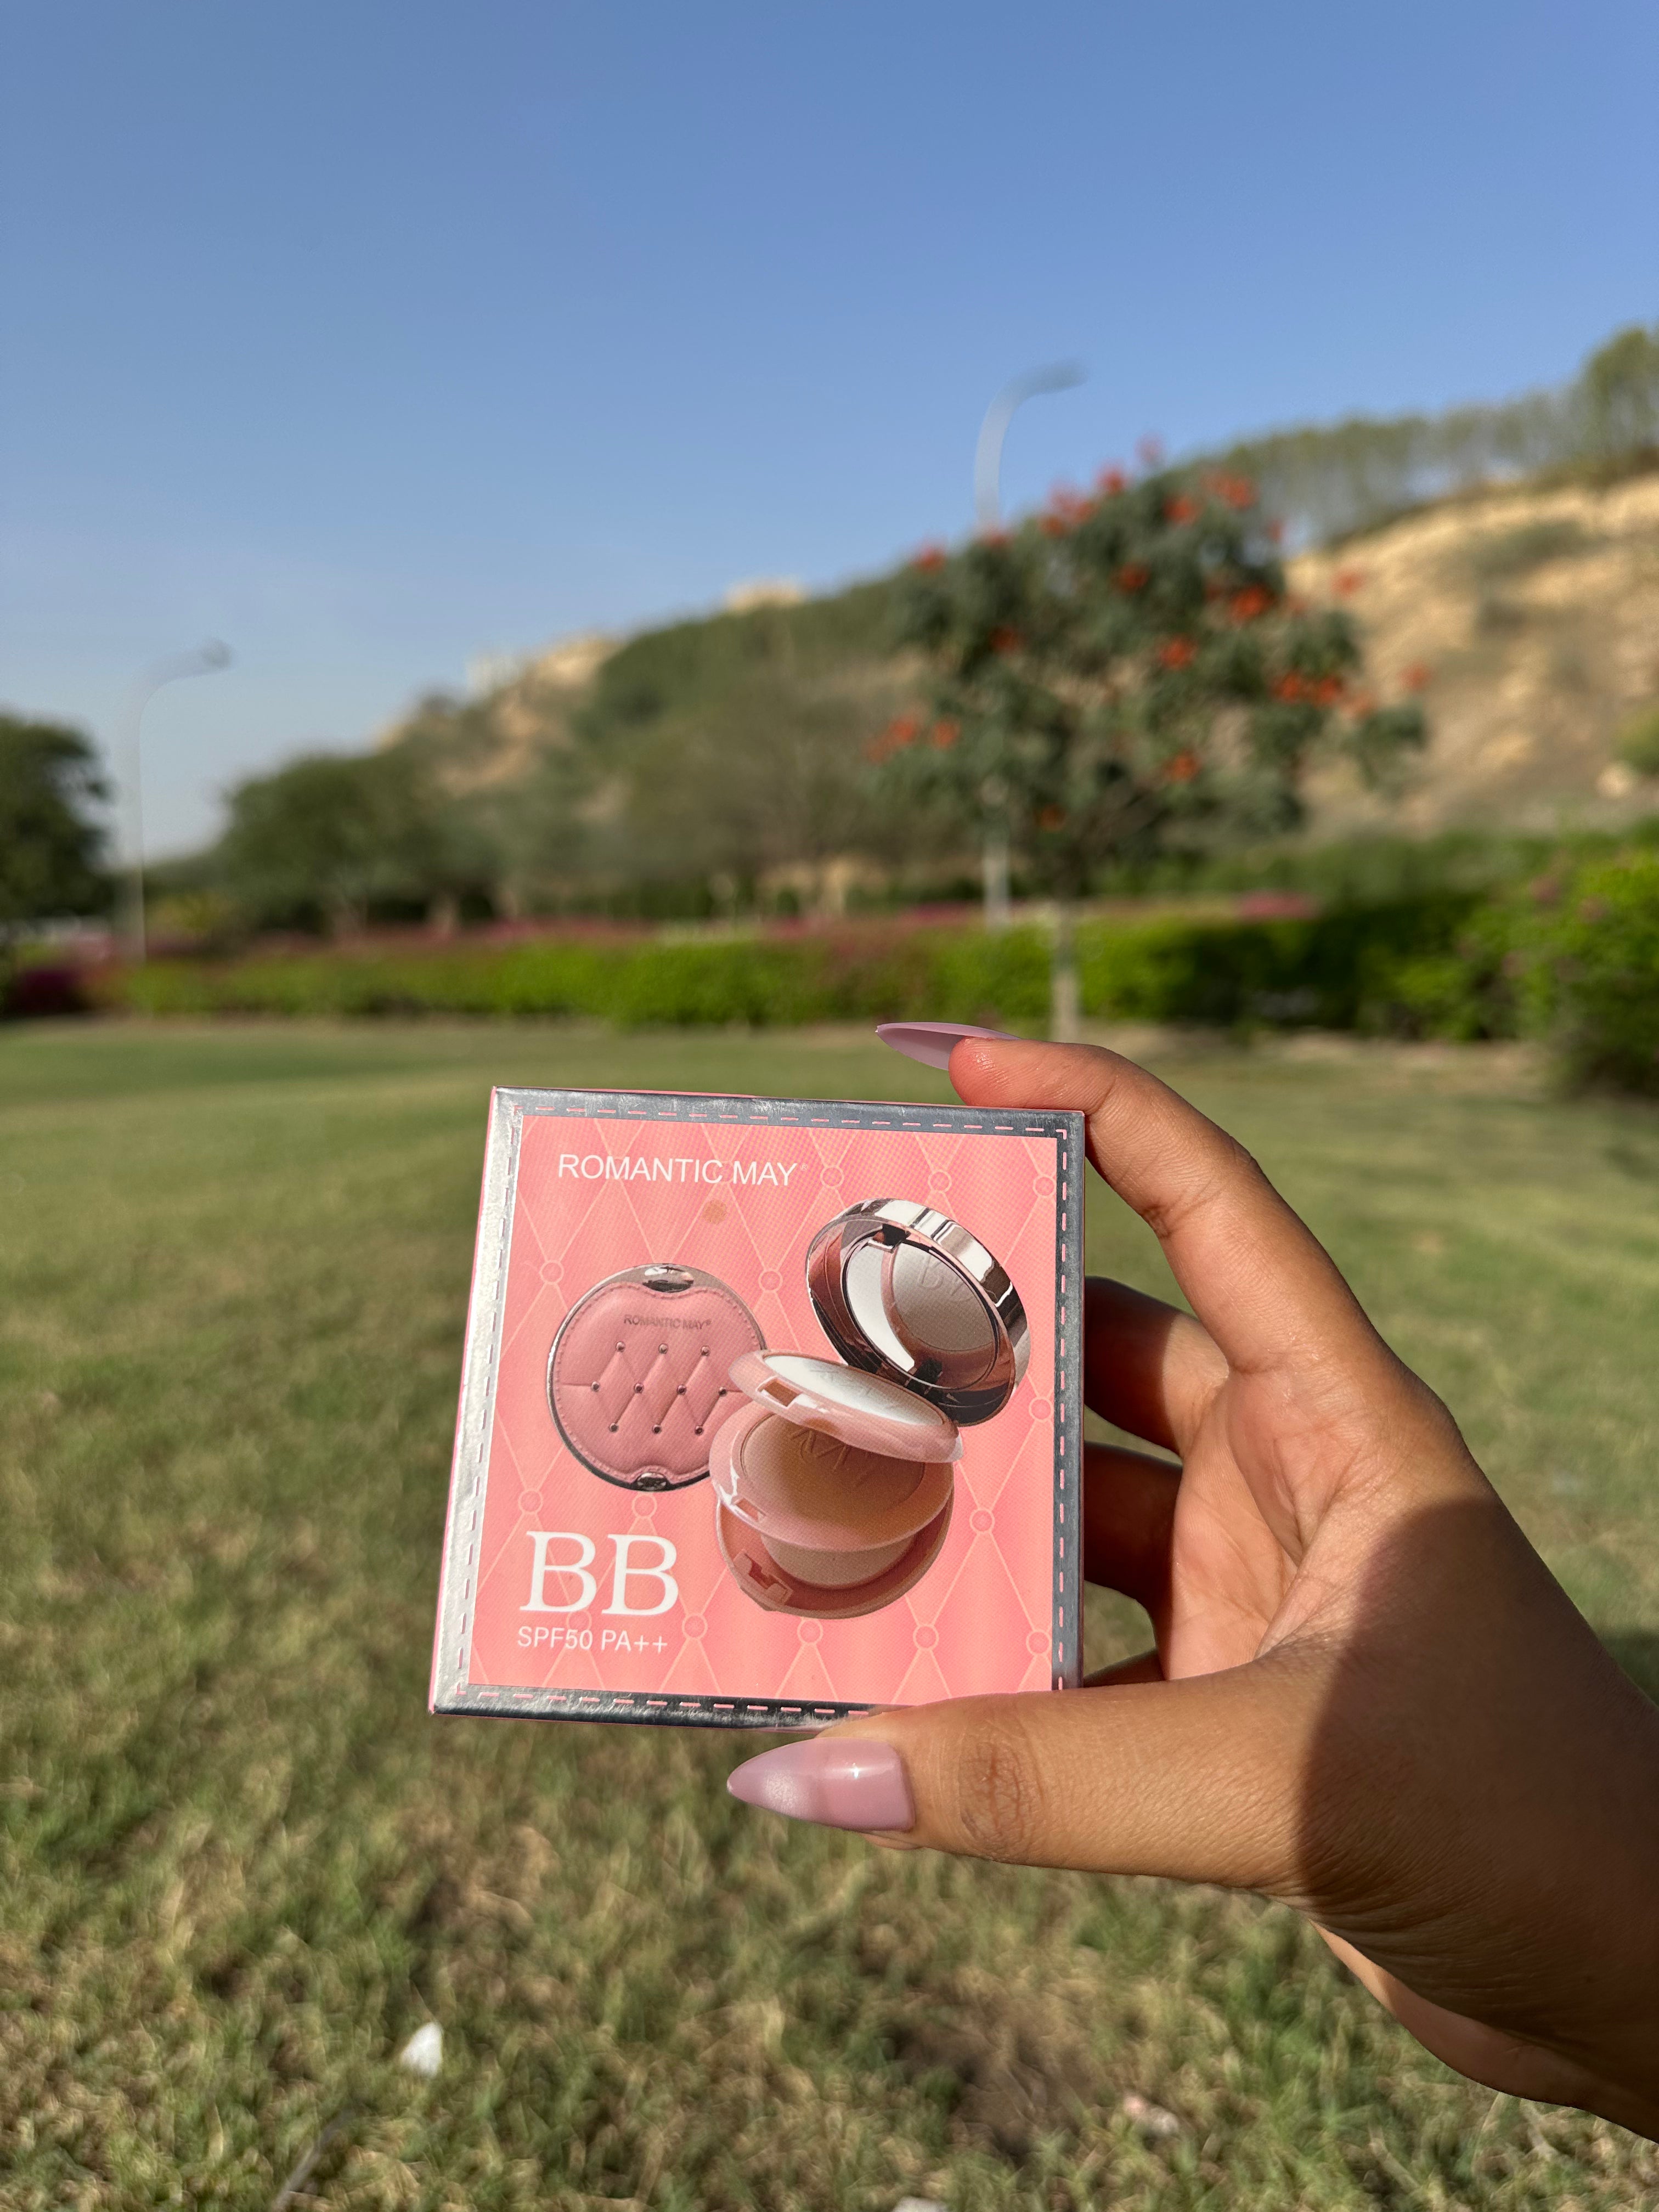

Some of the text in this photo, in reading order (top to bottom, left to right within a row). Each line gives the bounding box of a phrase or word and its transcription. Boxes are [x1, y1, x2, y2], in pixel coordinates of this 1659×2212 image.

[558, 1154, 798, 1186] ROMANTIC MAY
[624, 1314, 681, 1329] ROMANTIC
[520, 1530, 679, 1616] BB
[518, 1626, 668, 1654] SPF50 PA++
